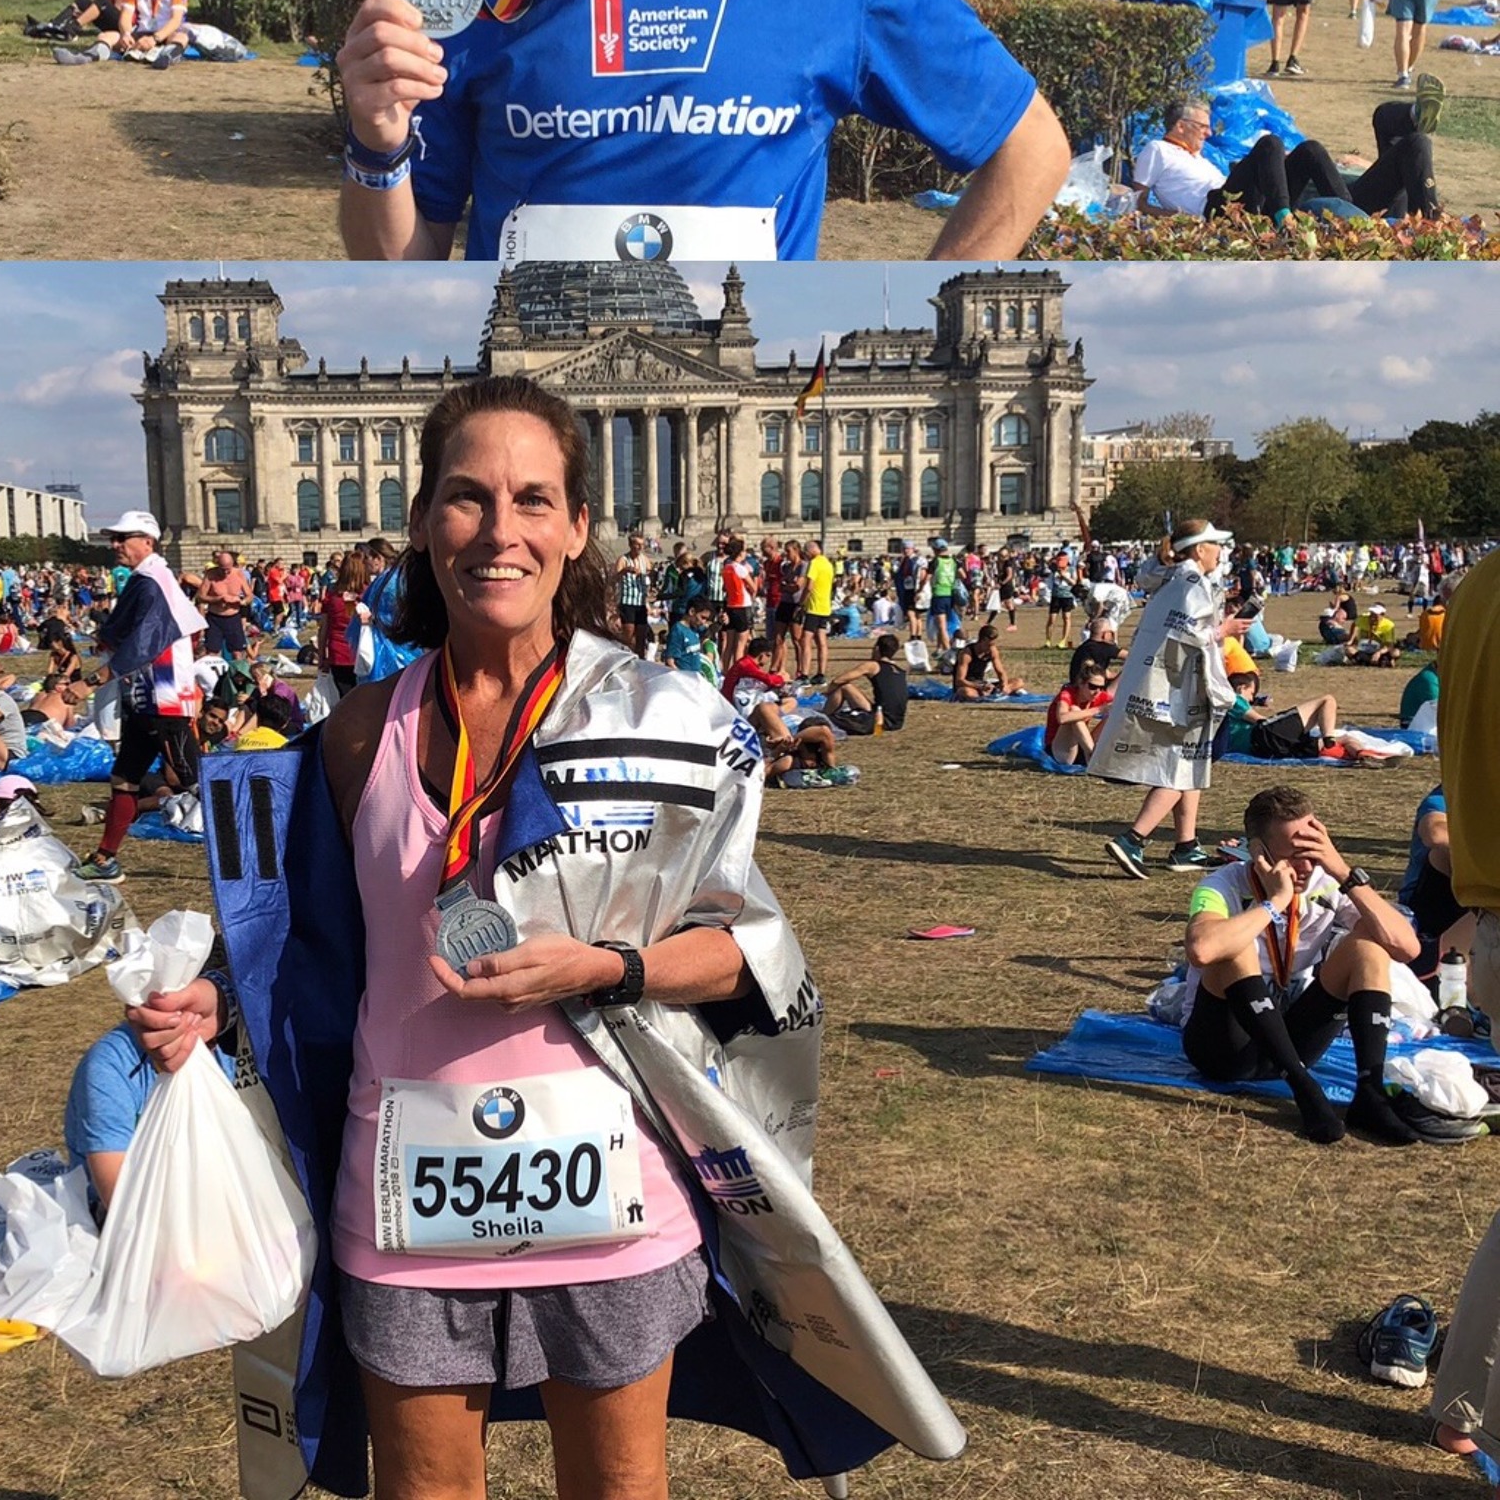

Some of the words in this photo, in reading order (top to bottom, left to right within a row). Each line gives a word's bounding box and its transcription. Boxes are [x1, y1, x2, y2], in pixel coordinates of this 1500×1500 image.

[628, 6, 708, 23] American
[628, 22, 687, 37] Cancer
[506, 95, 798, 140] DetermiNation
[620, 214, 669, 235] BMW
[478, 1088, 520, 1107] BMW
[610, 1132, 625, 1152] H
[412, 1142, 602, 1218] 55430
[472, 1217, 544, 1239] Sheila
